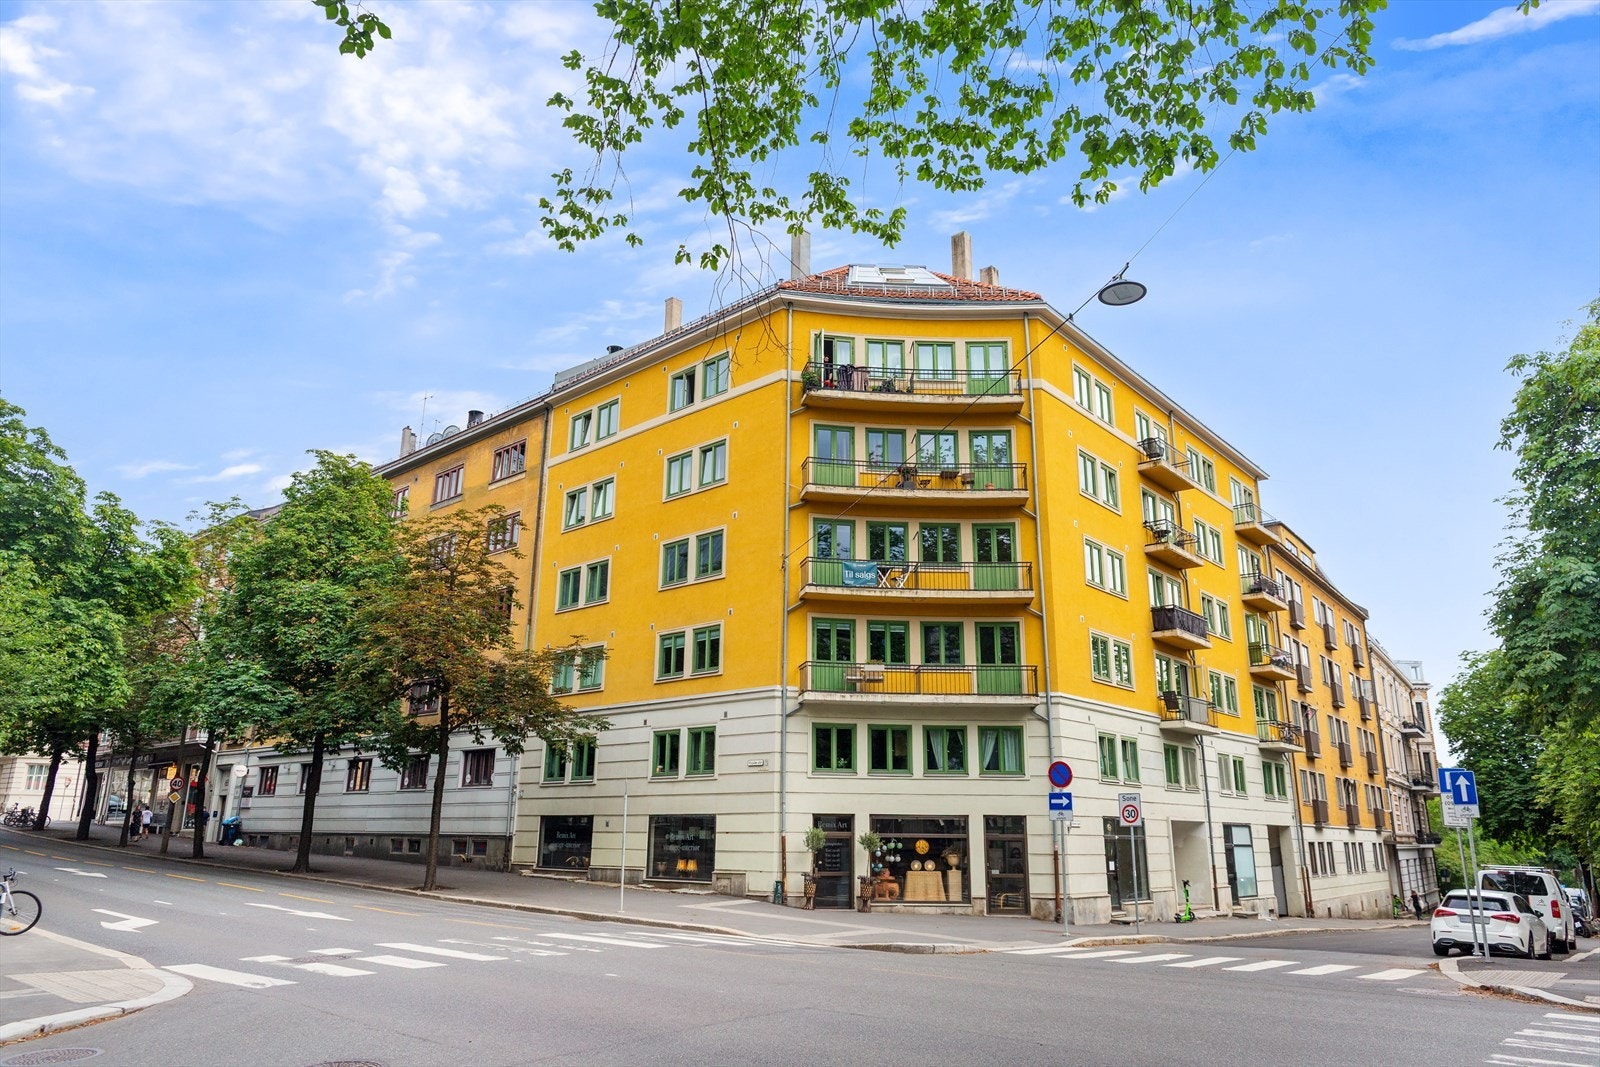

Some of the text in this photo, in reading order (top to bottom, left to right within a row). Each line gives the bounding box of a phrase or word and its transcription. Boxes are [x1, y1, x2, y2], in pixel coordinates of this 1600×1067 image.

[844, 570, 876, 580] Til salgs
[1126, 809, 1136, 818] 30
